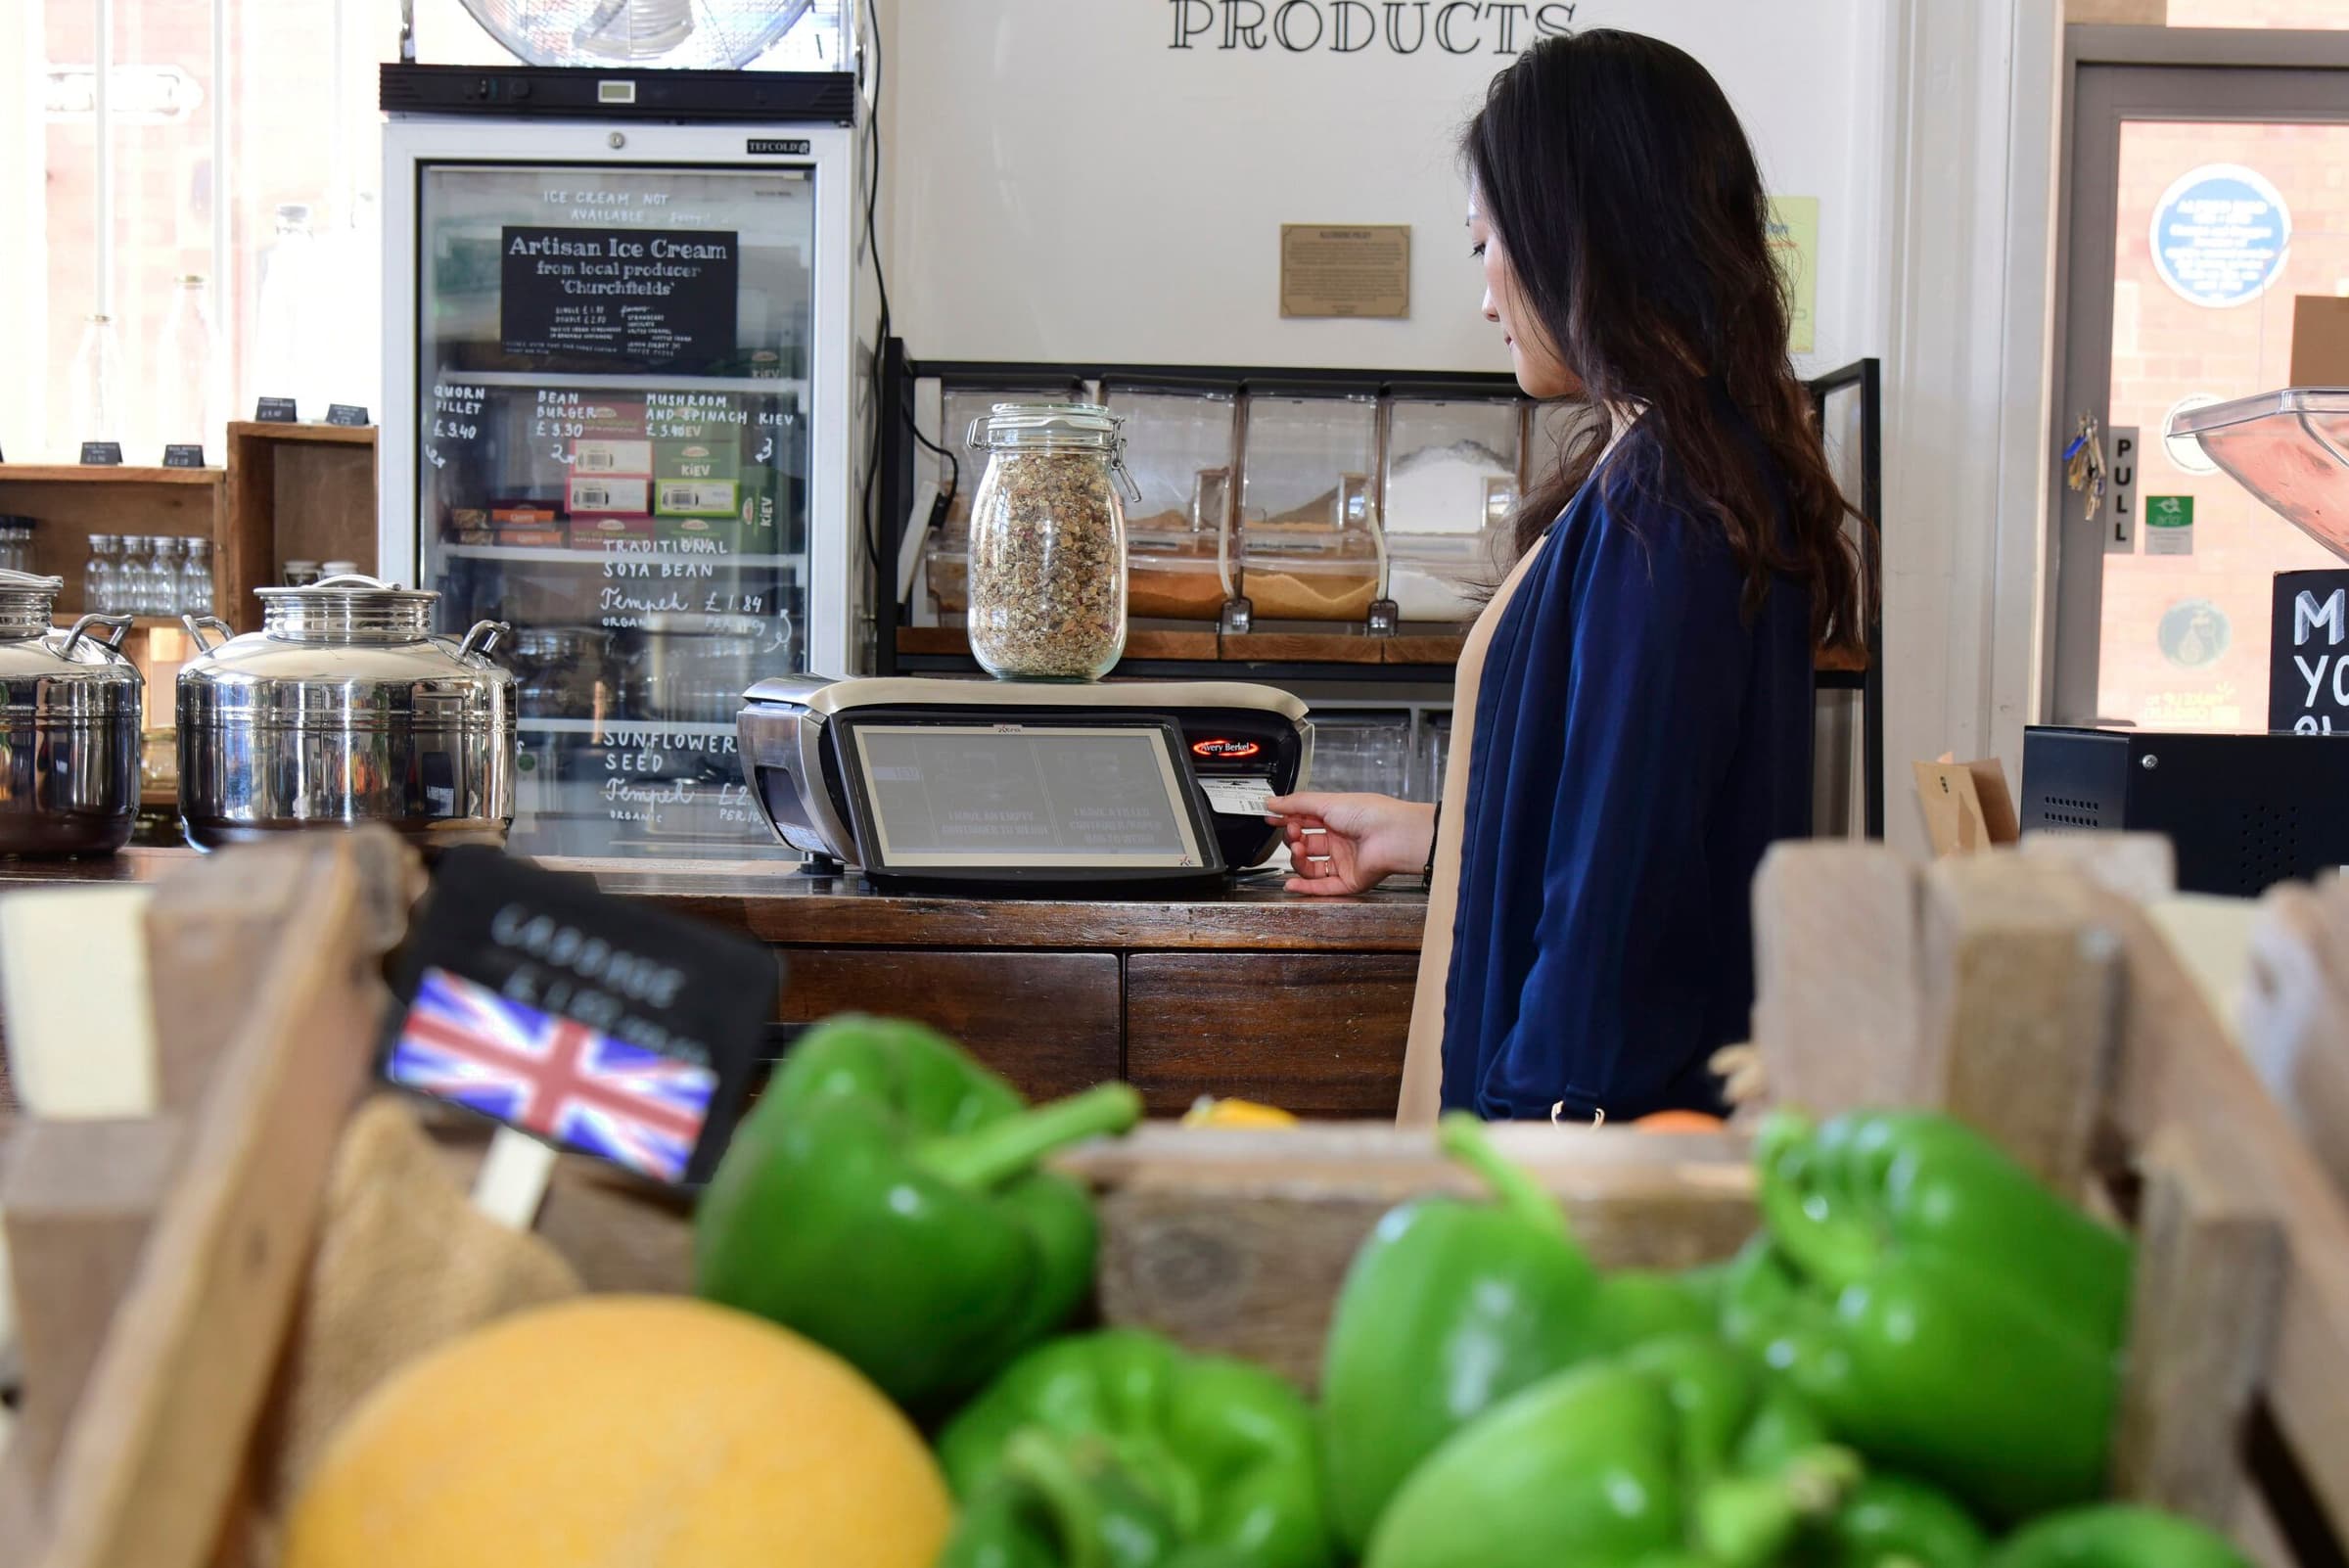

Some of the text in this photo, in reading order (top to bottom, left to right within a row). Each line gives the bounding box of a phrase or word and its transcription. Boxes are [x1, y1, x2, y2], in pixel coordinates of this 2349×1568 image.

[1169, 0, 1574, 55] PRODUCTS
[749, 142, 798, 151] TEFCOLD
[543, 190, 668, 205] ICE CREAM NOT
[572, 208, 643, 221] AVAILABLE
[509, 236, 727, 259] Artisan Ice Cream
[536, 260, 702, 280] from local producer
[434, 386, 485, 399] QUORN
[538, 391, 579, 404] BEAN
[646, 393, 727, 408] MUSHROOM
[436, 402, 482, 415] FILLET
[536, 407, 597, 420] BURGER
[645, 408, 794, 426] AND SPINACH KIEV
[2115, 438, 2132, 541] PULL
[604, 540, 728, 555] TRADITIONAL
[603, 562, 714, 577] SOYA BEAN
[601, 587, 689, 618] Tempeh
[604, 731, 737, 754] SUNFLOWER
[1224, 742, 1250, 753] Berkel
[605, 754, 663, 772] SEED
[606, 777, 695, 812] Tempeh
[610, 809, 663, 823] ORGANIC
